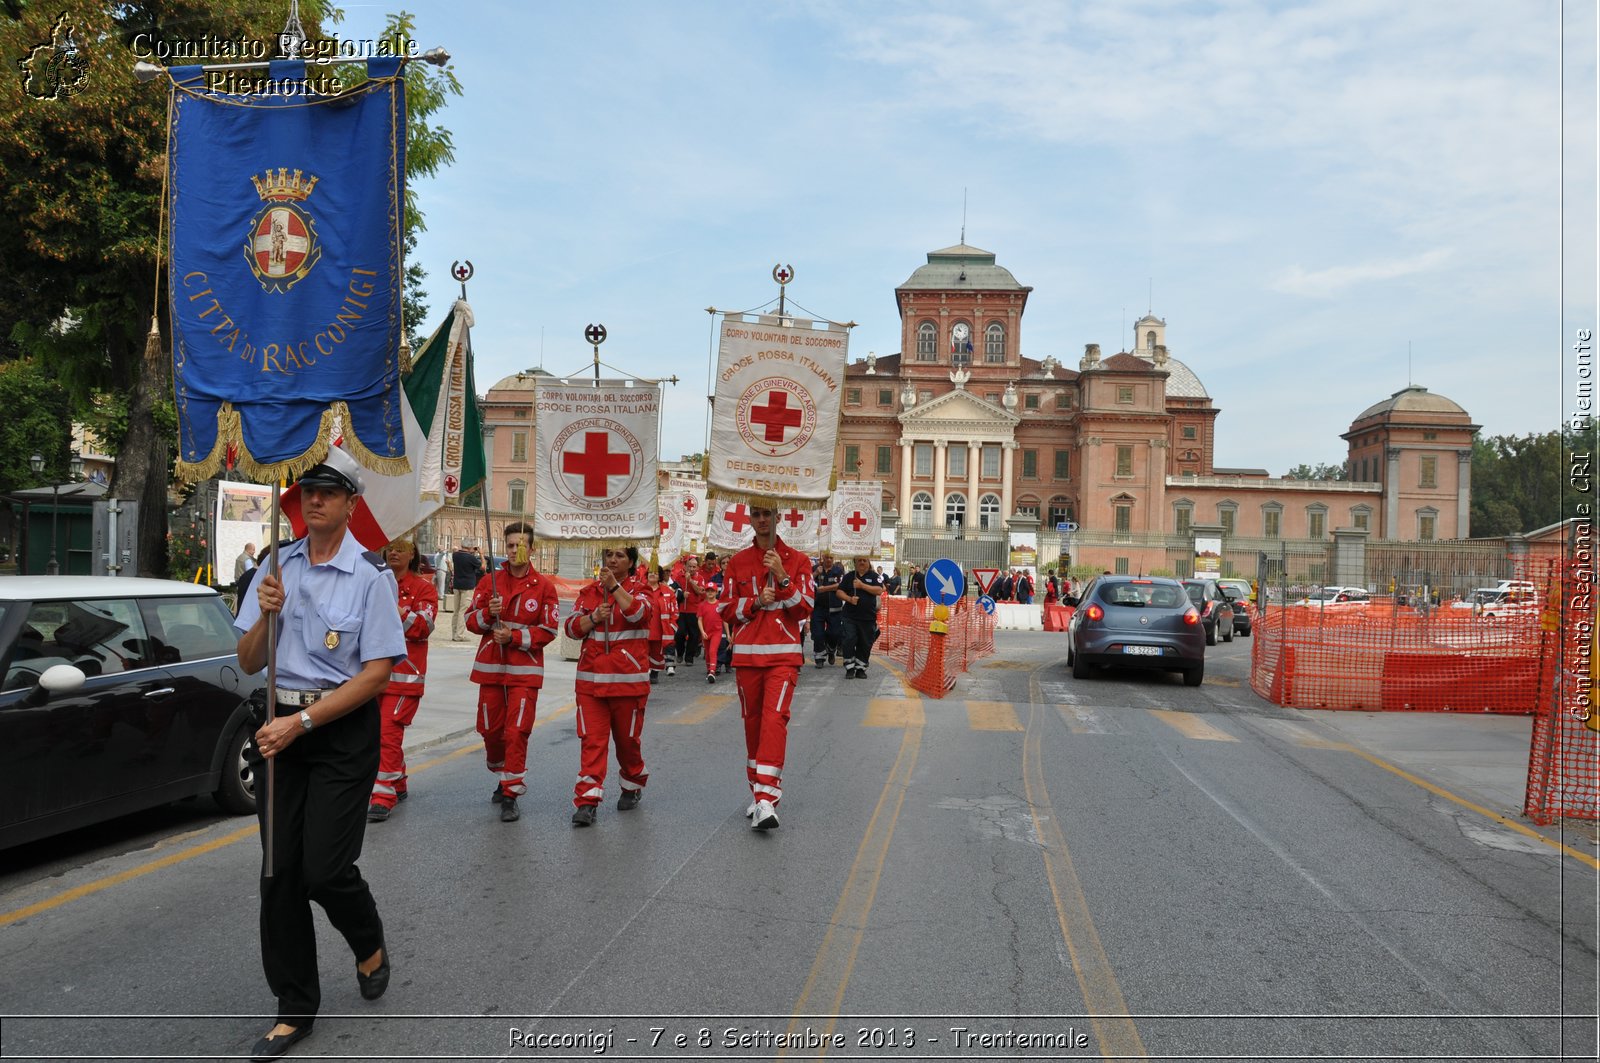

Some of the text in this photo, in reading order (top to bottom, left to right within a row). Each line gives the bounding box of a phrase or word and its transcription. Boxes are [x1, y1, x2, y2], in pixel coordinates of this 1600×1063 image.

[240, 344, 257, 363] DI
[261, 268, 378, 375] RACCONIGI
[726, 328, 841, 348] CORPO VOLONTARI DEL SOCCORSO
[721, 350, 838, 392] CROCE ROSSA ITALIANA
[541, 391, 653, 403] CORPO VOLONTARI DEL SOCCORSO
[449, 394, 463, 431] ROSSA
[537, 402, 658, 414] CROCE ROSSA ITALIANA
[738, 389, 755, 443] CONVENZIONE
[755, 383, 763, 391] DI
[763, 379, 798, 392] GINEVRA
[797, 389, 808, 399] 22
[804, 398, 815, 433] AGOSTO
[553, 419, 641, 455] CONVENZIONE DI GINEVRA
[446, 433, 462, 468] CROCE
[726, 459, 815, 477] DELEGAZIONE DI
[737, 477, 799, 494] PAESANA
[544, 512, 647, 521] COMITATO LOCALE DI
[560, 525, 634, 535] RACCONIGI
